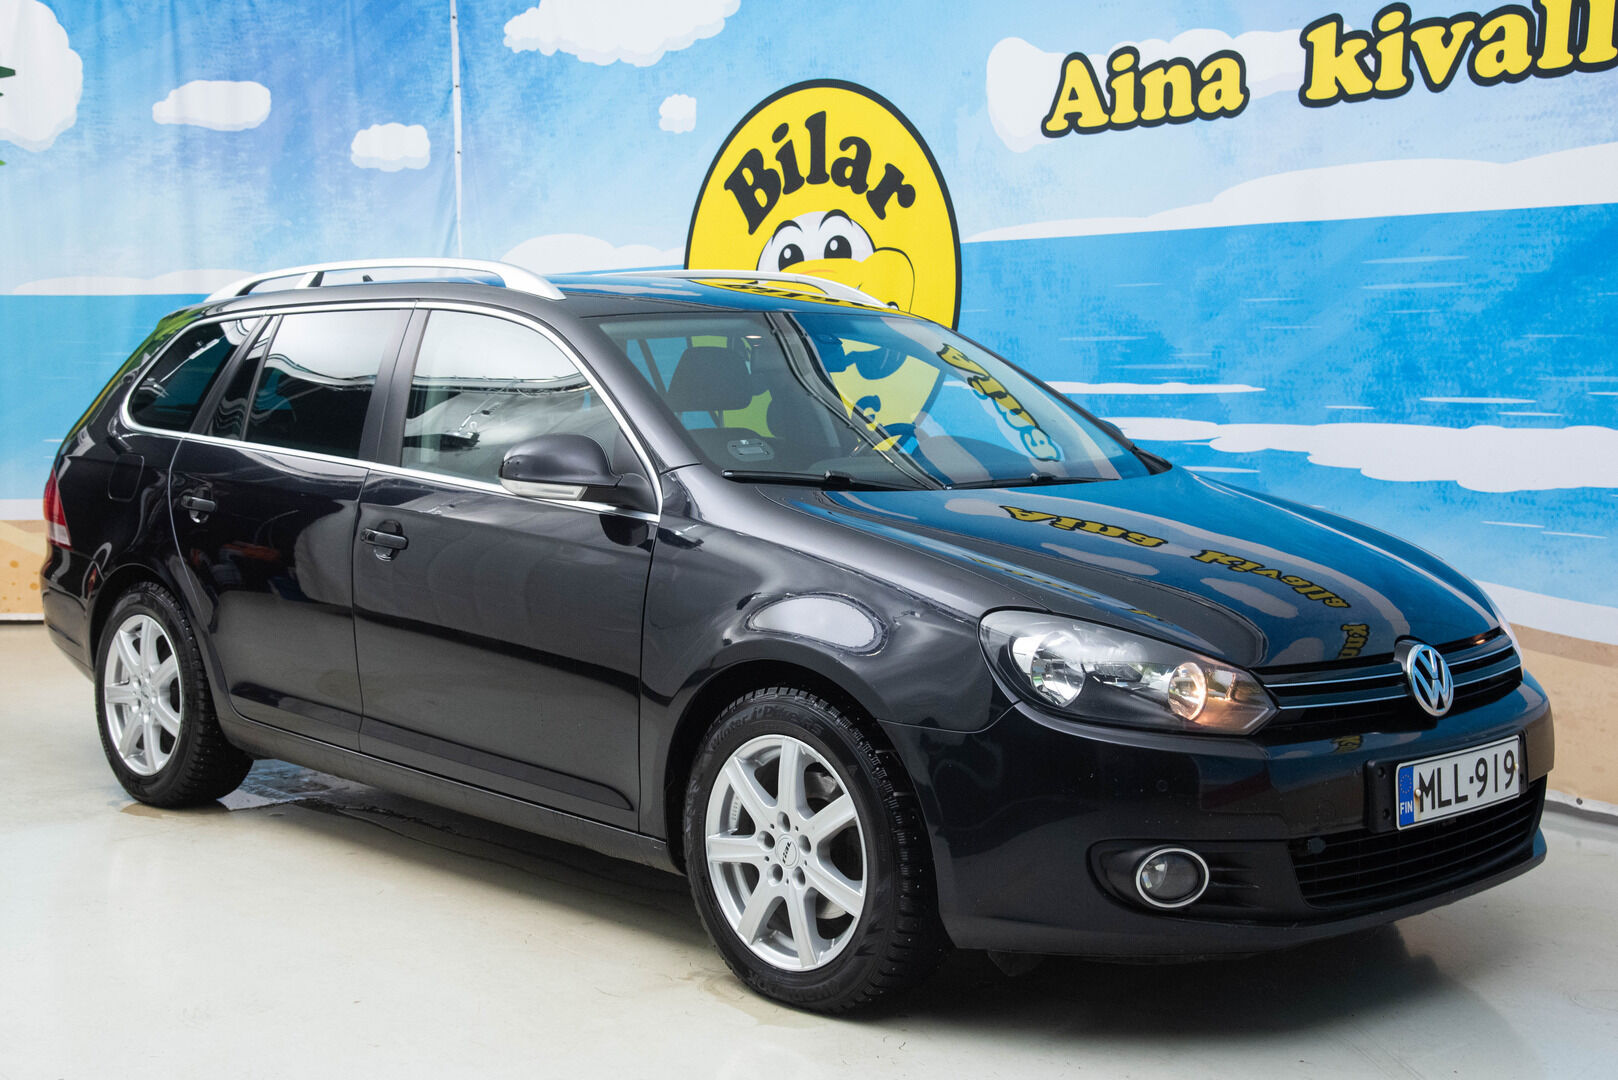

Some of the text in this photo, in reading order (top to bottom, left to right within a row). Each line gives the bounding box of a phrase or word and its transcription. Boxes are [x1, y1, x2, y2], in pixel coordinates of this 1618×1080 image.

[1042, 0, 1618, 137] Aina kivall
[724, 110, 916, 235] Bilar
[1400, 801, 1414, 815] FIN
[1418, 749, 1515, 813] MLL-919
